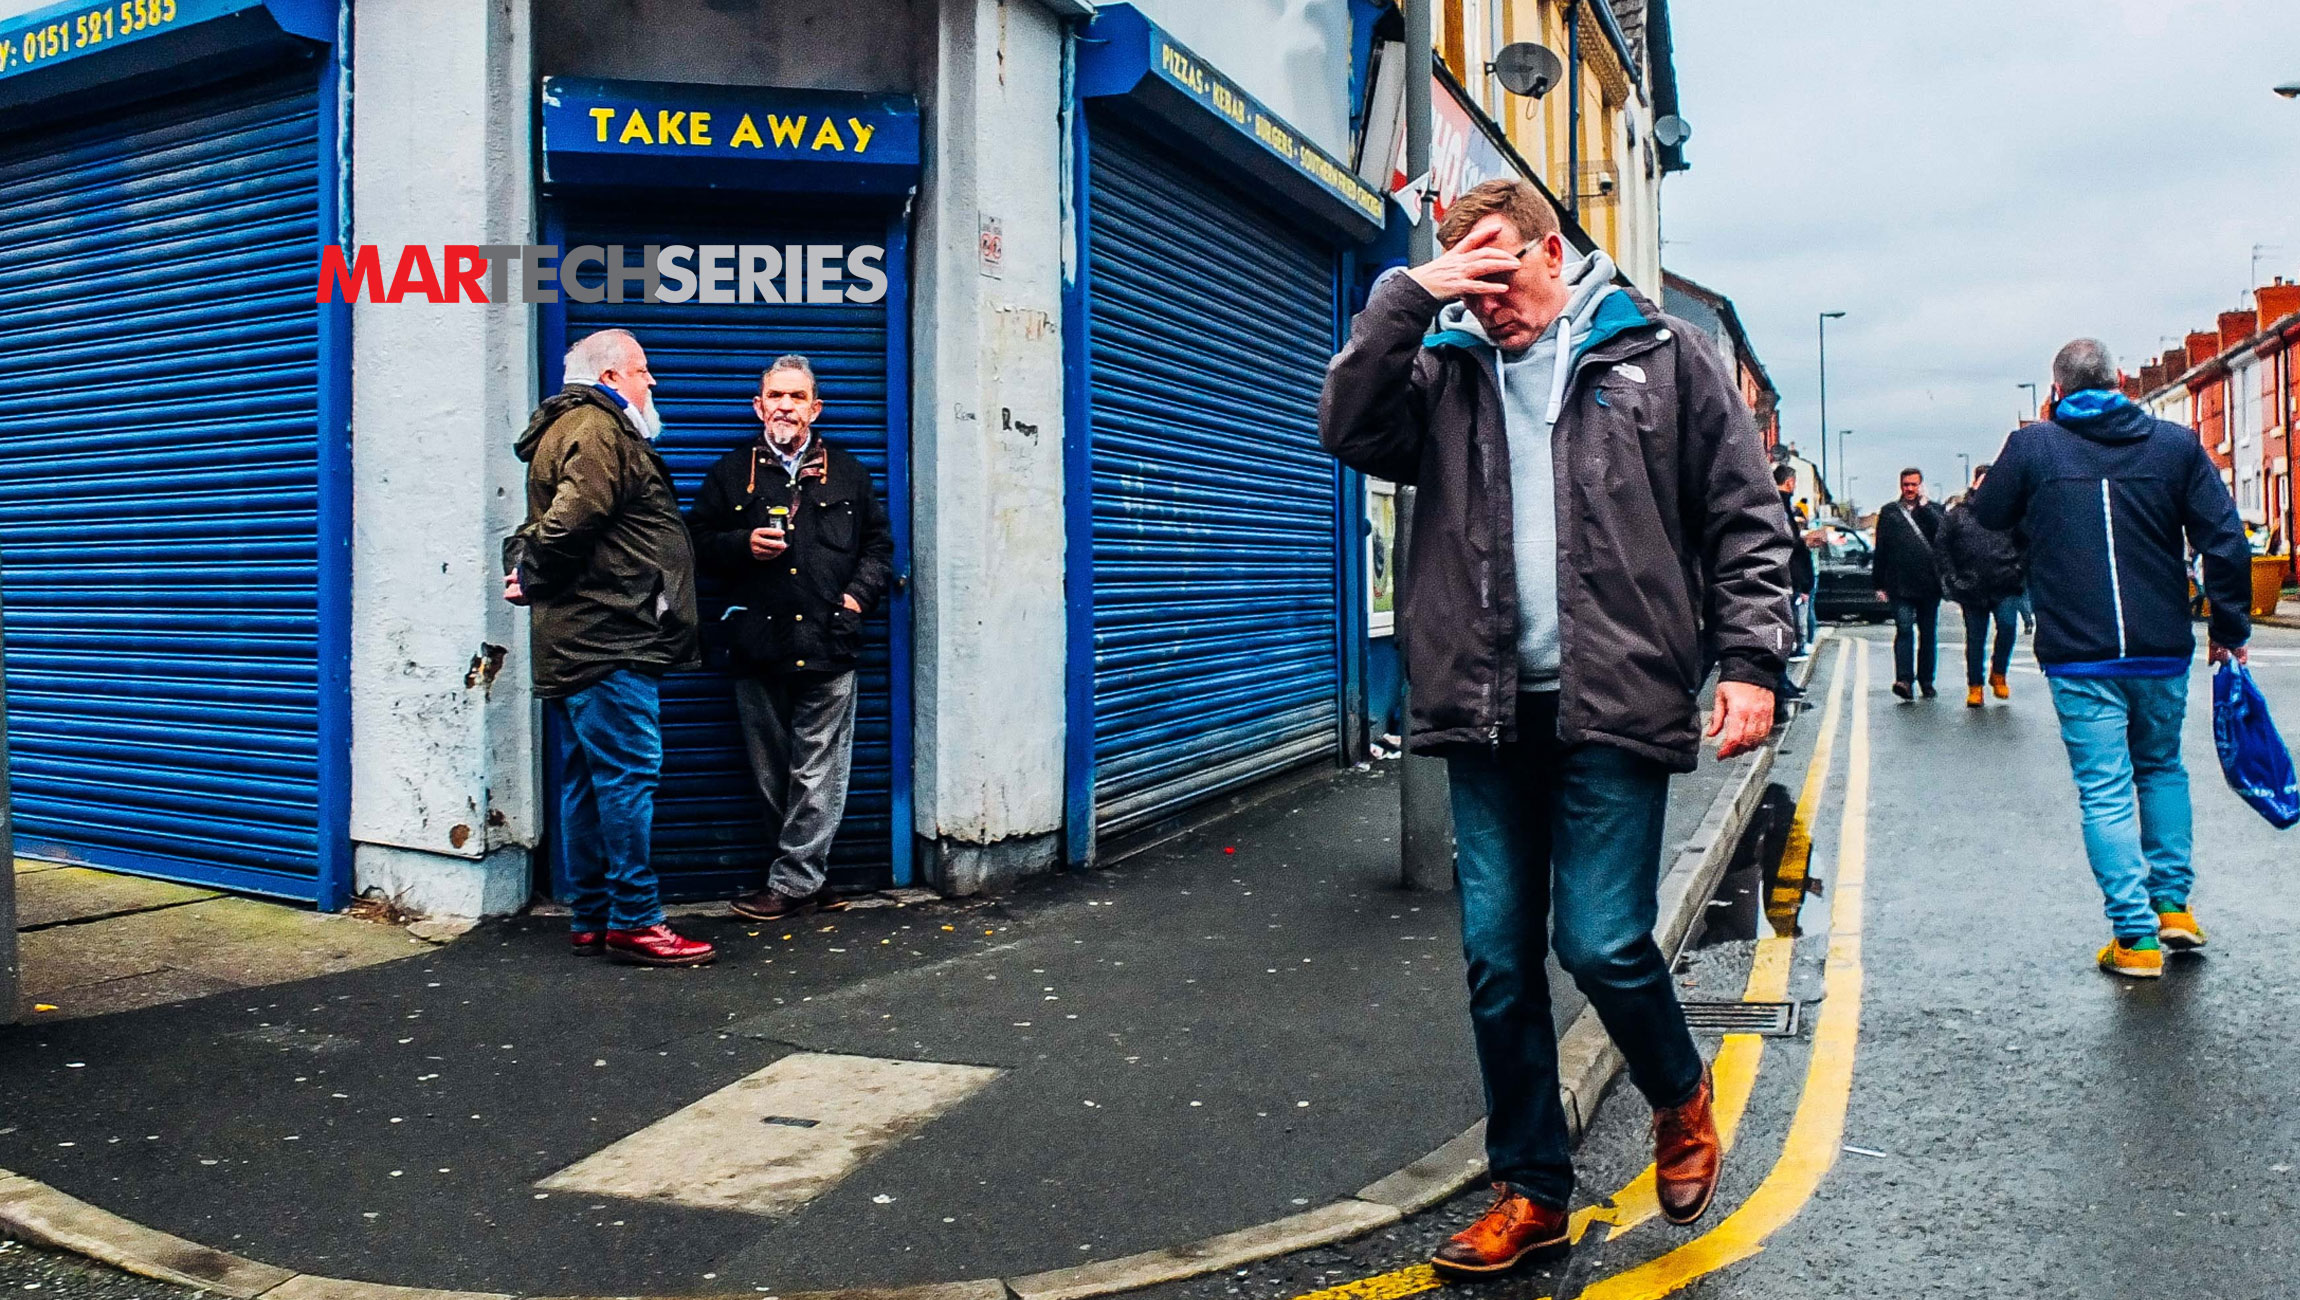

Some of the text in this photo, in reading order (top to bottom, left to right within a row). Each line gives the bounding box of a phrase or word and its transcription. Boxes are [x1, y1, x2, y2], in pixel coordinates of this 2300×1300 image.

[23, 20, 69, 64] 0151
[75, 6, 113, 48] 521
[1162, 43, 1204, 94] PIZZAS
[588, 107, 875, 153] TAKE AWAY
